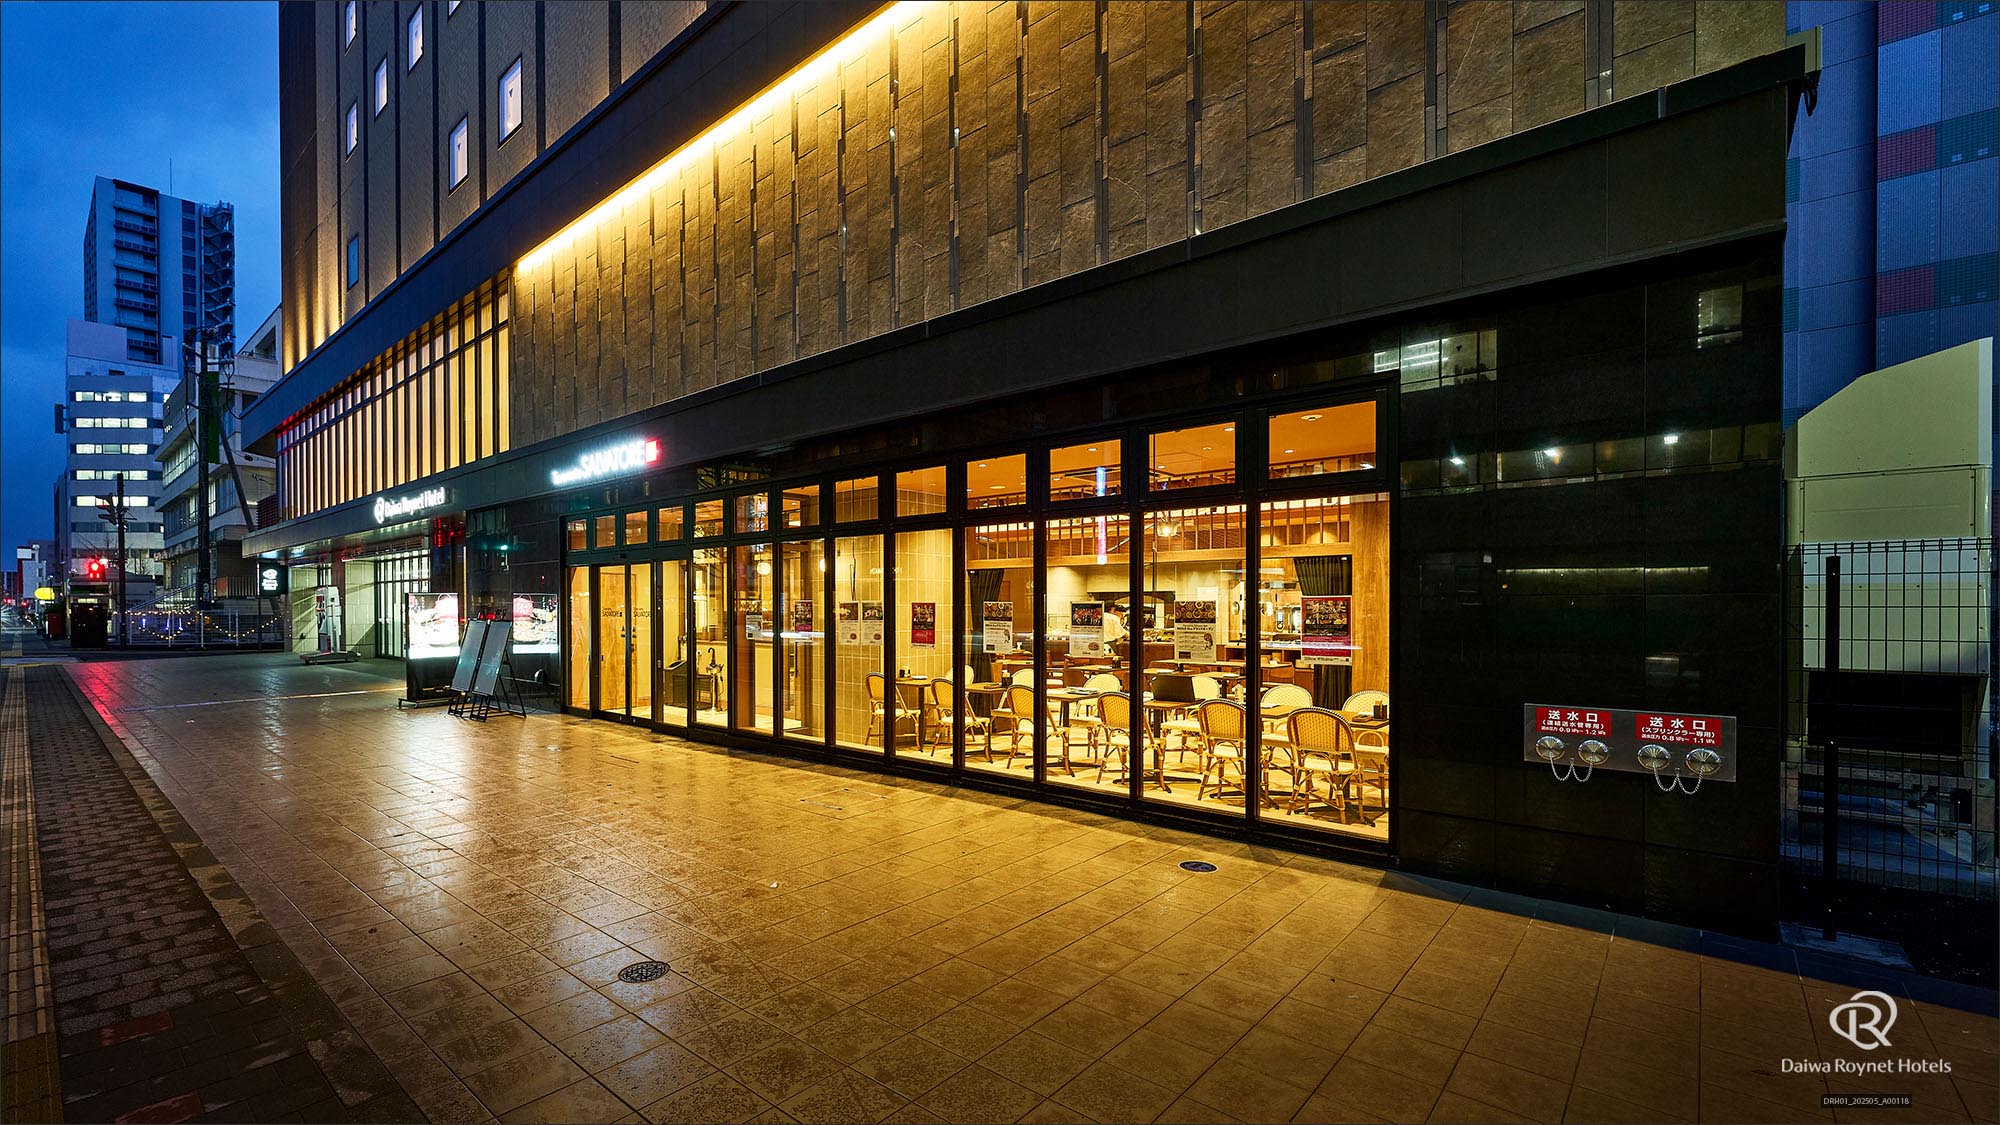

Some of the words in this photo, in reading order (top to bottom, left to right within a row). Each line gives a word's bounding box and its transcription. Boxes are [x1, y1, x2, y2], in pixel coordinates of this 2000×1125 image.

[424, 486, 445, 508] Hotel
[1548, 710, 1598, 722] 送水口
[1649, 717, 1706, 730] 送水口
